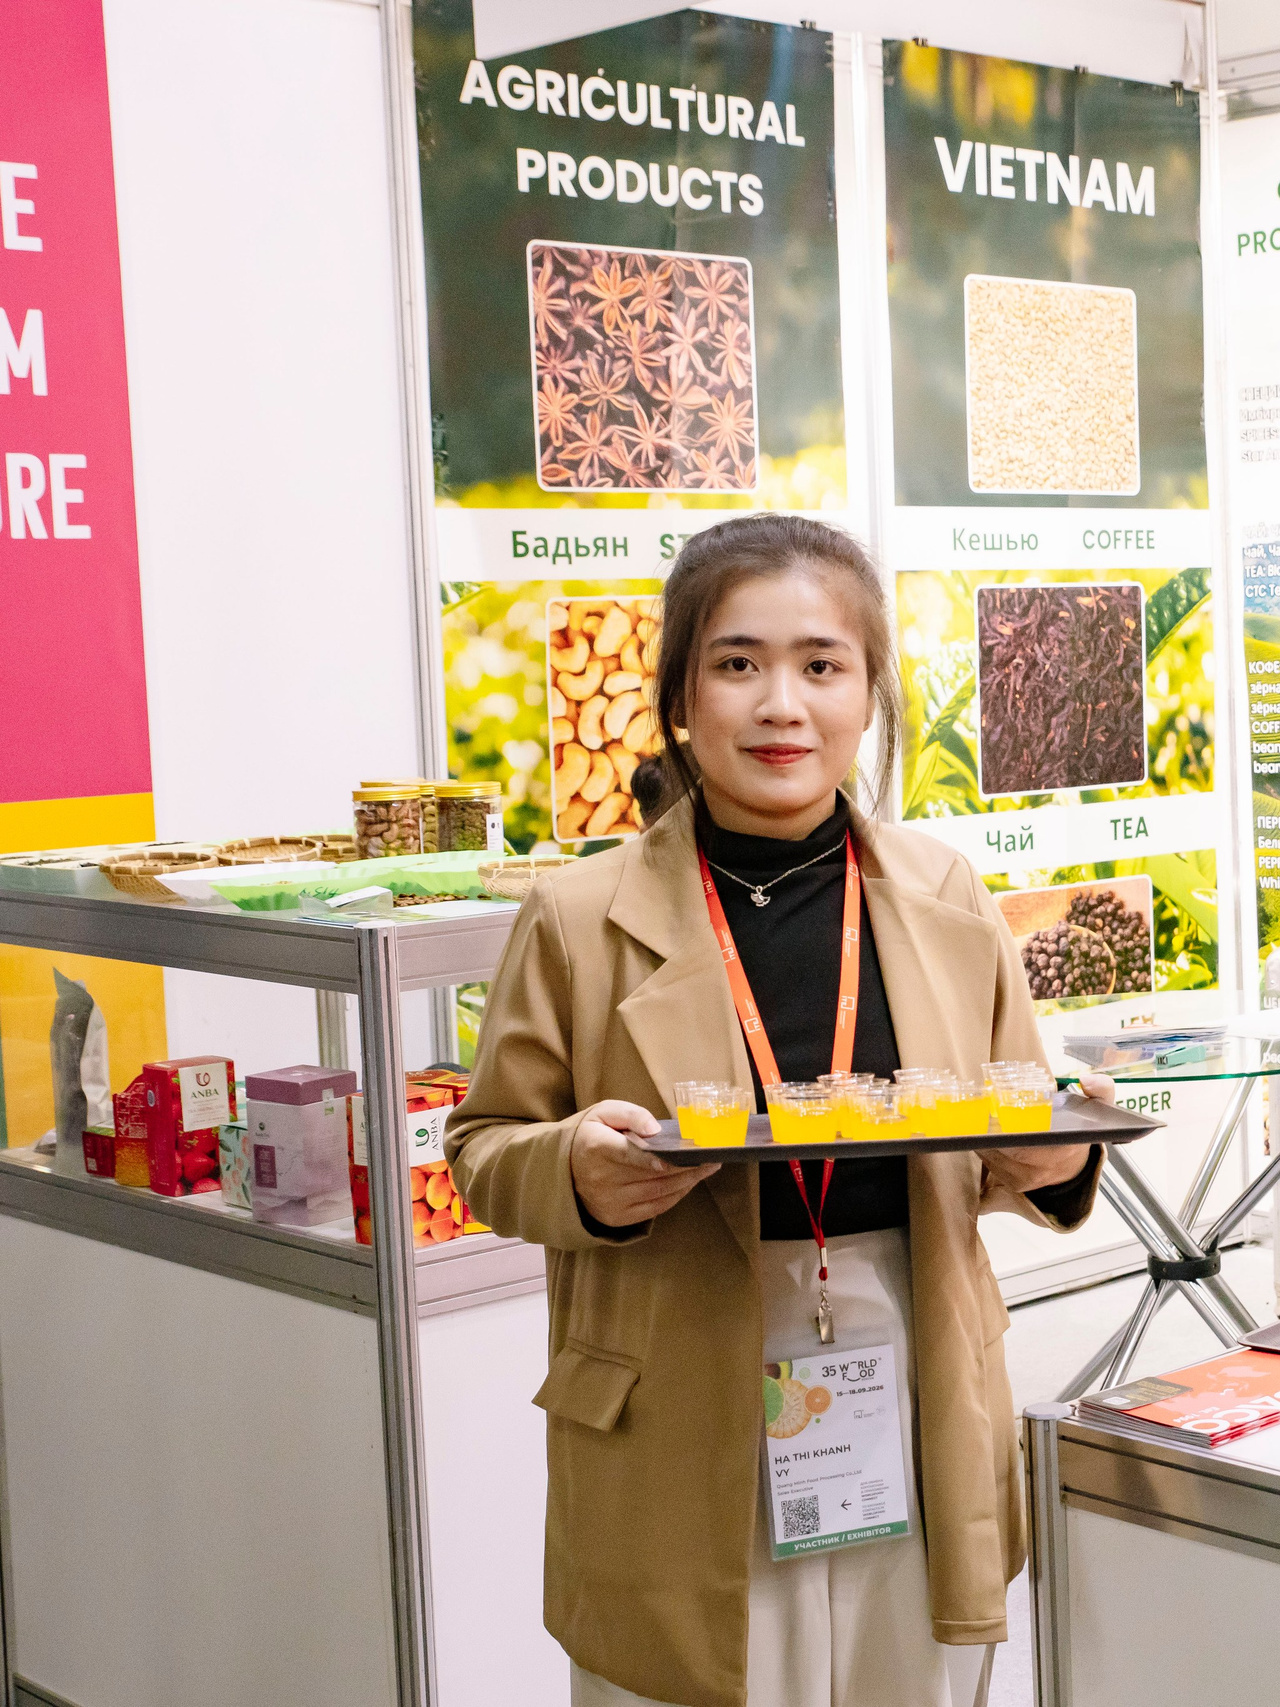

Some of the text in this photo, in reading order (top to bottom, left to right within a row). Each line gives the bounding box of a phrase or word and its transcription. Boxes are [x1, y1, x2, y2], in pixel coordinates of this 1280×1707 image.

[460, 60, 805, 147] AGRICULTURAL
[517, 147, 765, 216] PRODUCTS
[934, 136, 1155, 216] VIETNAM
[0, 453, 91, 539] RE
[511, 530, 628, 565] Бадьян
[952, 527, 1039, 551] Кешью
[1082, 529, 1155, 550] COFFEE
[986, 825, 1035, 853] Чай
[1110, 816, 1149, 841] TEA
[191, 1088, 220, 1099] ANBA
[430, 1116, 440, 1151] ANBA
[822, 1365, 836, 1378] 35
[774, 1444, 851, 1465] HA THI KHANH
[775, 1468, 790, 1478] VY
[794, 1536, 840, 1551] УЧАСТНИК
[847, 1526, 891, 1541] EXHIBITOR
